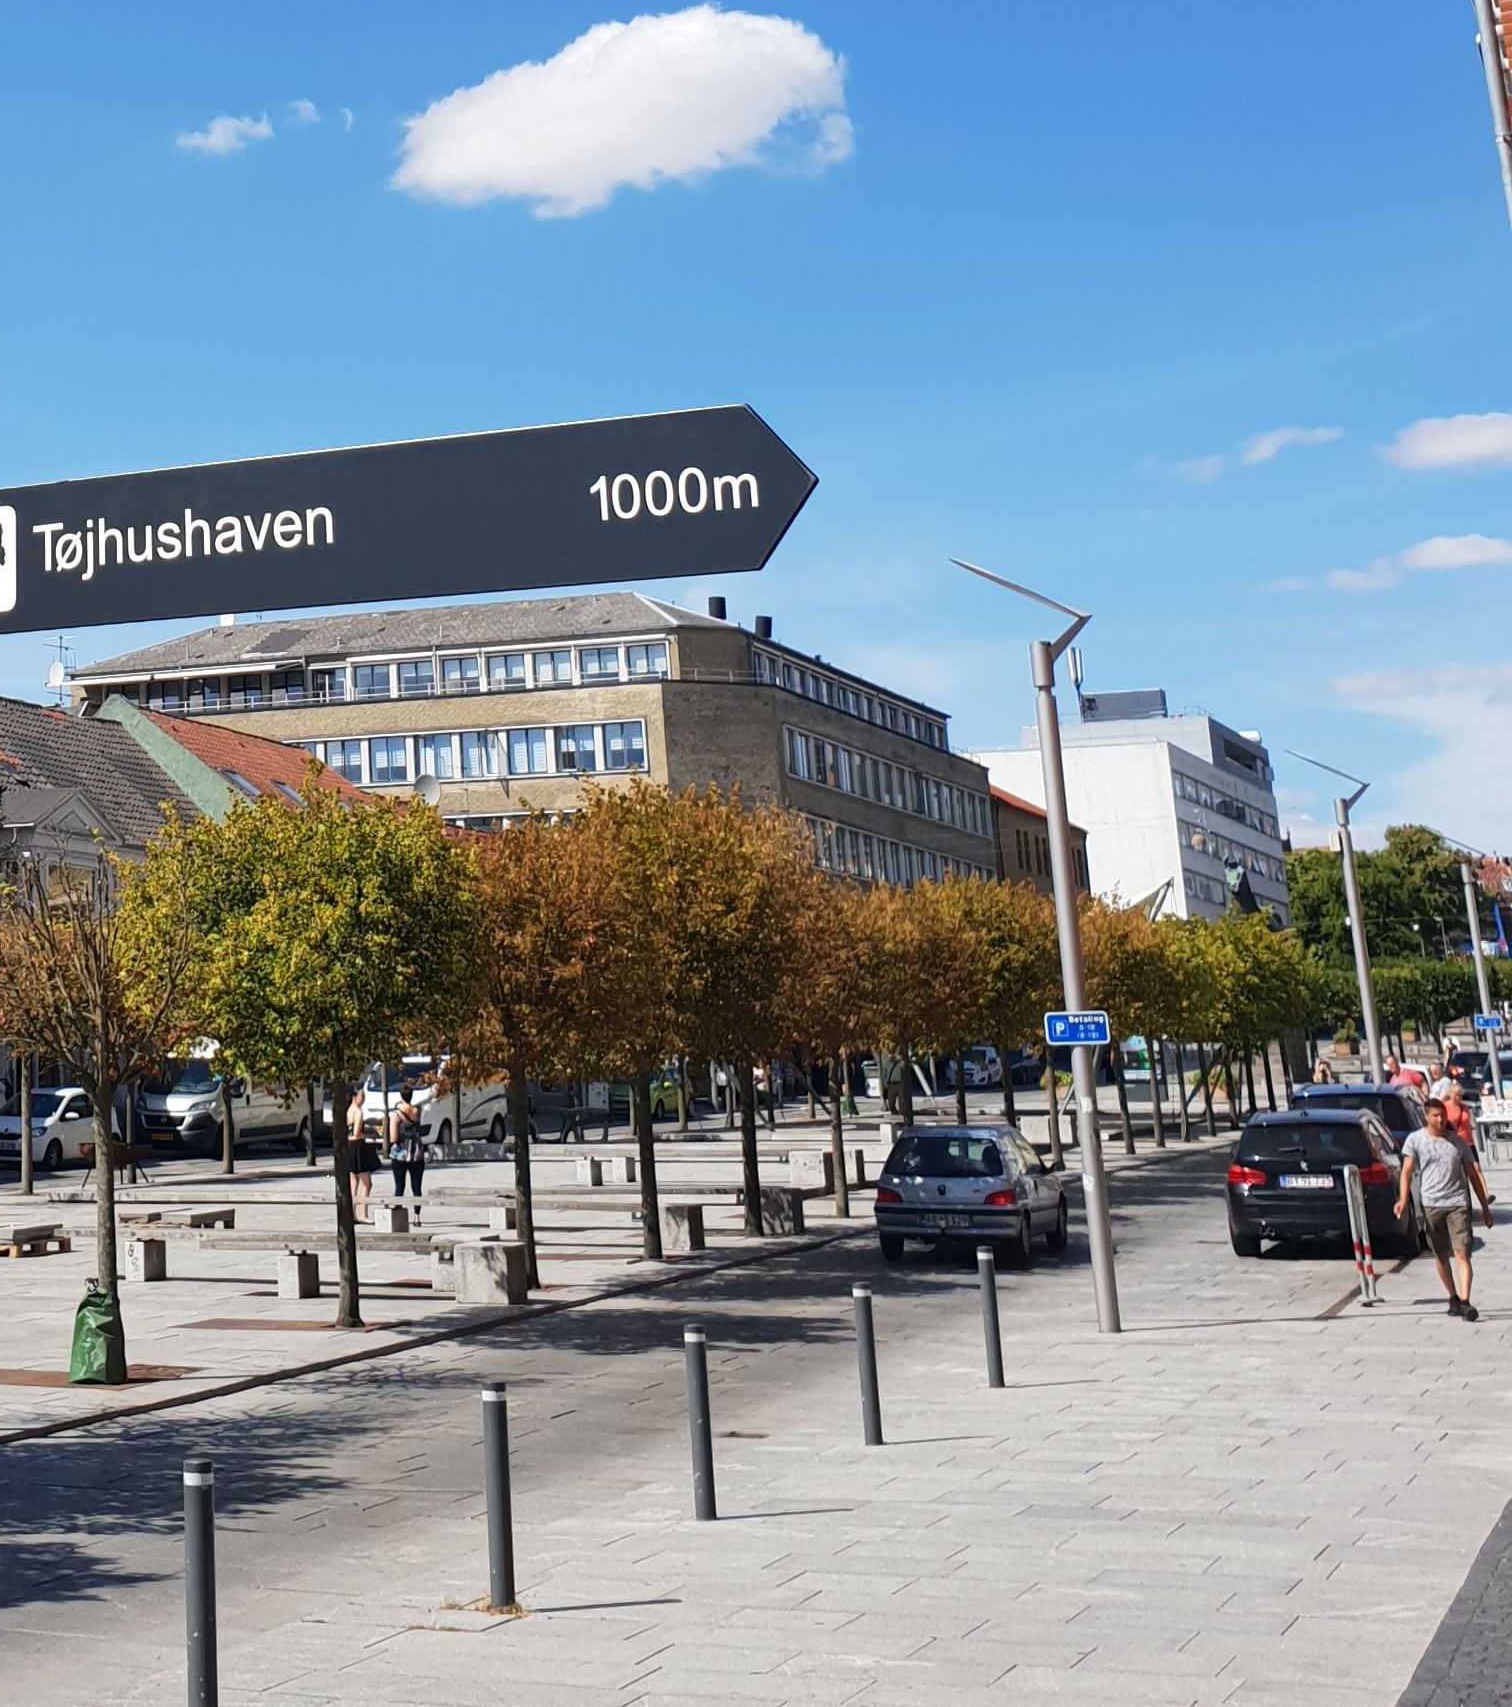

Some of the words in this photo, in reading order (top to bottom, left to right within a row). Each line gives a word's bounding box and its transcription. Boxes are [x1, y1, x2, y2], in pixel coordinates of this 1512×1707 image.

[33, 507, 333, 580] Tøjhushaven
[590, 467, 758, 520] 1000m
[1055, 1021, 1065, 1035] P
